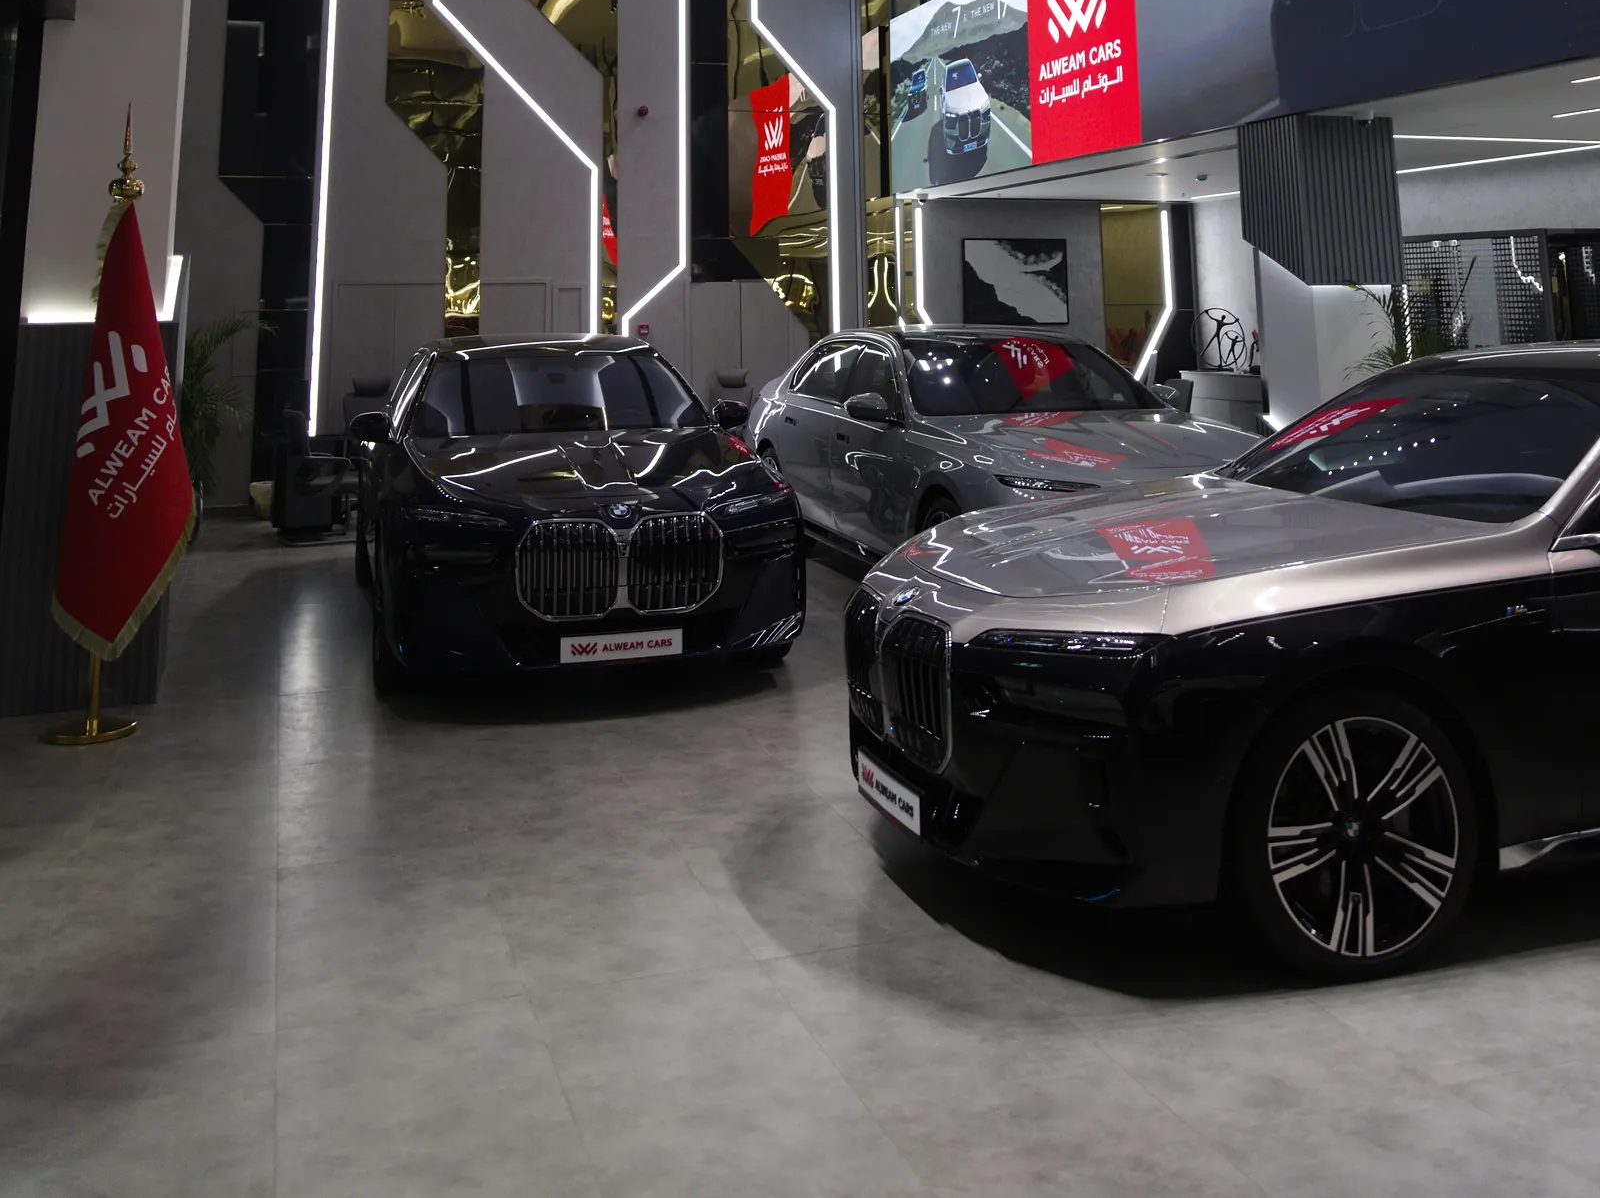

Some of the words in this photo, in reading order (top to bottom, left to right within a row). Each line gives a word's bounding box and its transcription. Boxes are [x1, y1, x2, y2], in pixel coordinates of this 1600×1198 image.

[930, 26, 940, 36] THE
[941, 22, 952, 32] NEW
[952, 6, 961, 38] 7
[971, 7, 982, 18] THE
[982, 2, 995, 14] NEW
[1039, 50, 1086, 81] ALWEAM
[1089, 39, 1122, 65] CARS
[1039, 78, 1080, 108] للسيارات
[88, 407, 157, 506] ALWEAM
[106, 434, 168, 519] للسيارات
[602, 641, 644, 653] ALWEAM
[647, 638, 673, 649] CARS
[897, 796, 914, 818] CARS
